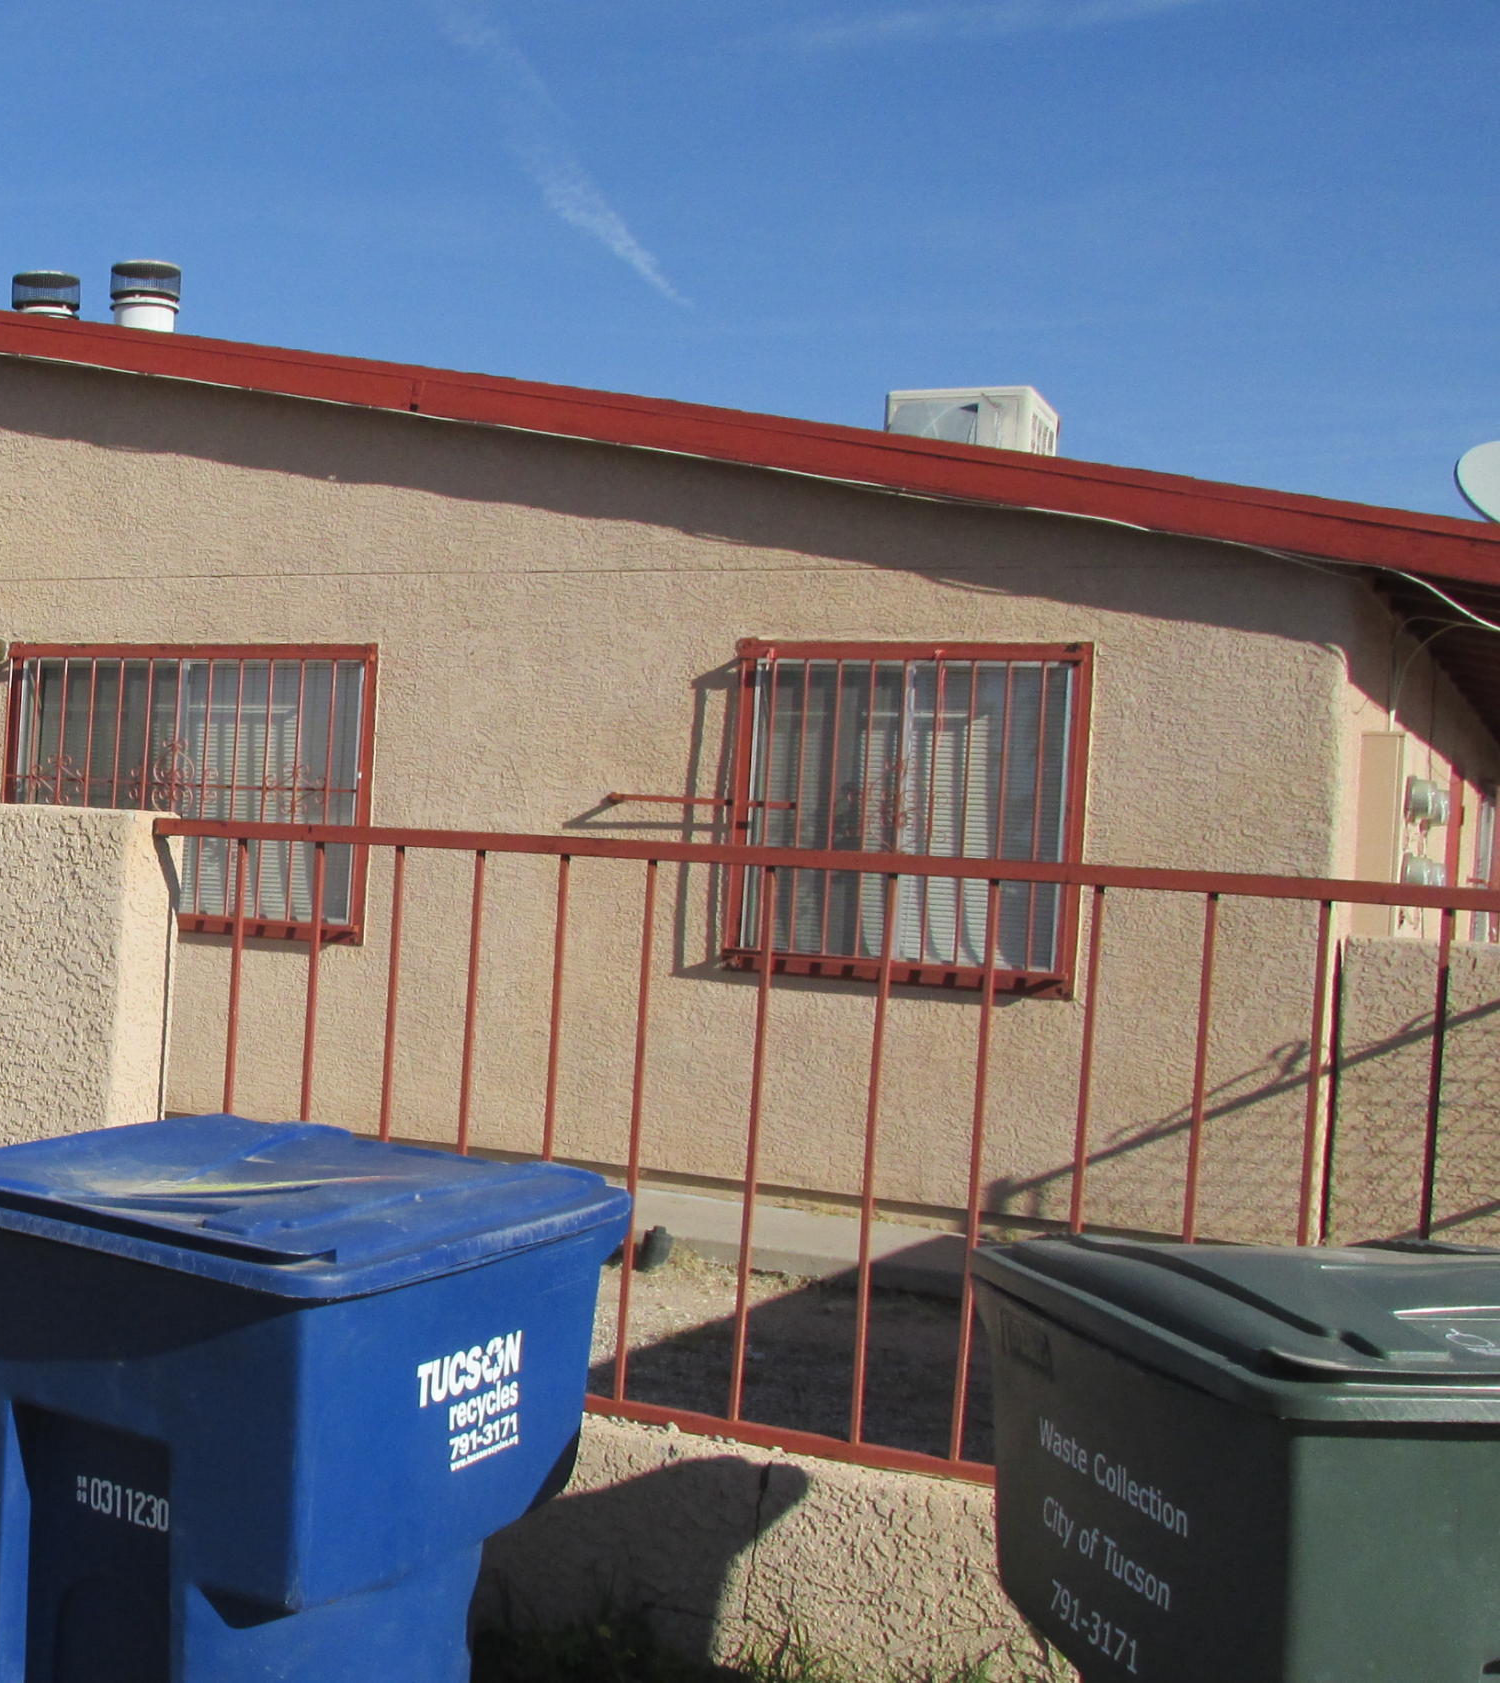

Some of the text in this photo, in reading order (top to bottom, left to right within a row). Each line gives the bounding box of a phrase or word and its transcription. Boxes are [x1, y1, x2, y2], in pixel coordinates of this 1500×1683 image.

[417, 1329, 523, 1408] TUCSON
[448, 1380, 519, 1432] recycles
[449, 1412, 518, 1461] 791-3171
[90, 1477, 170, 1532] 0311230
[1038, 1415, 1189, 1538] Waste Collection
[1042, 1496, 1172, 1612] City of Tucson
[1050, 1578, 1139, 1676] 791-3171
